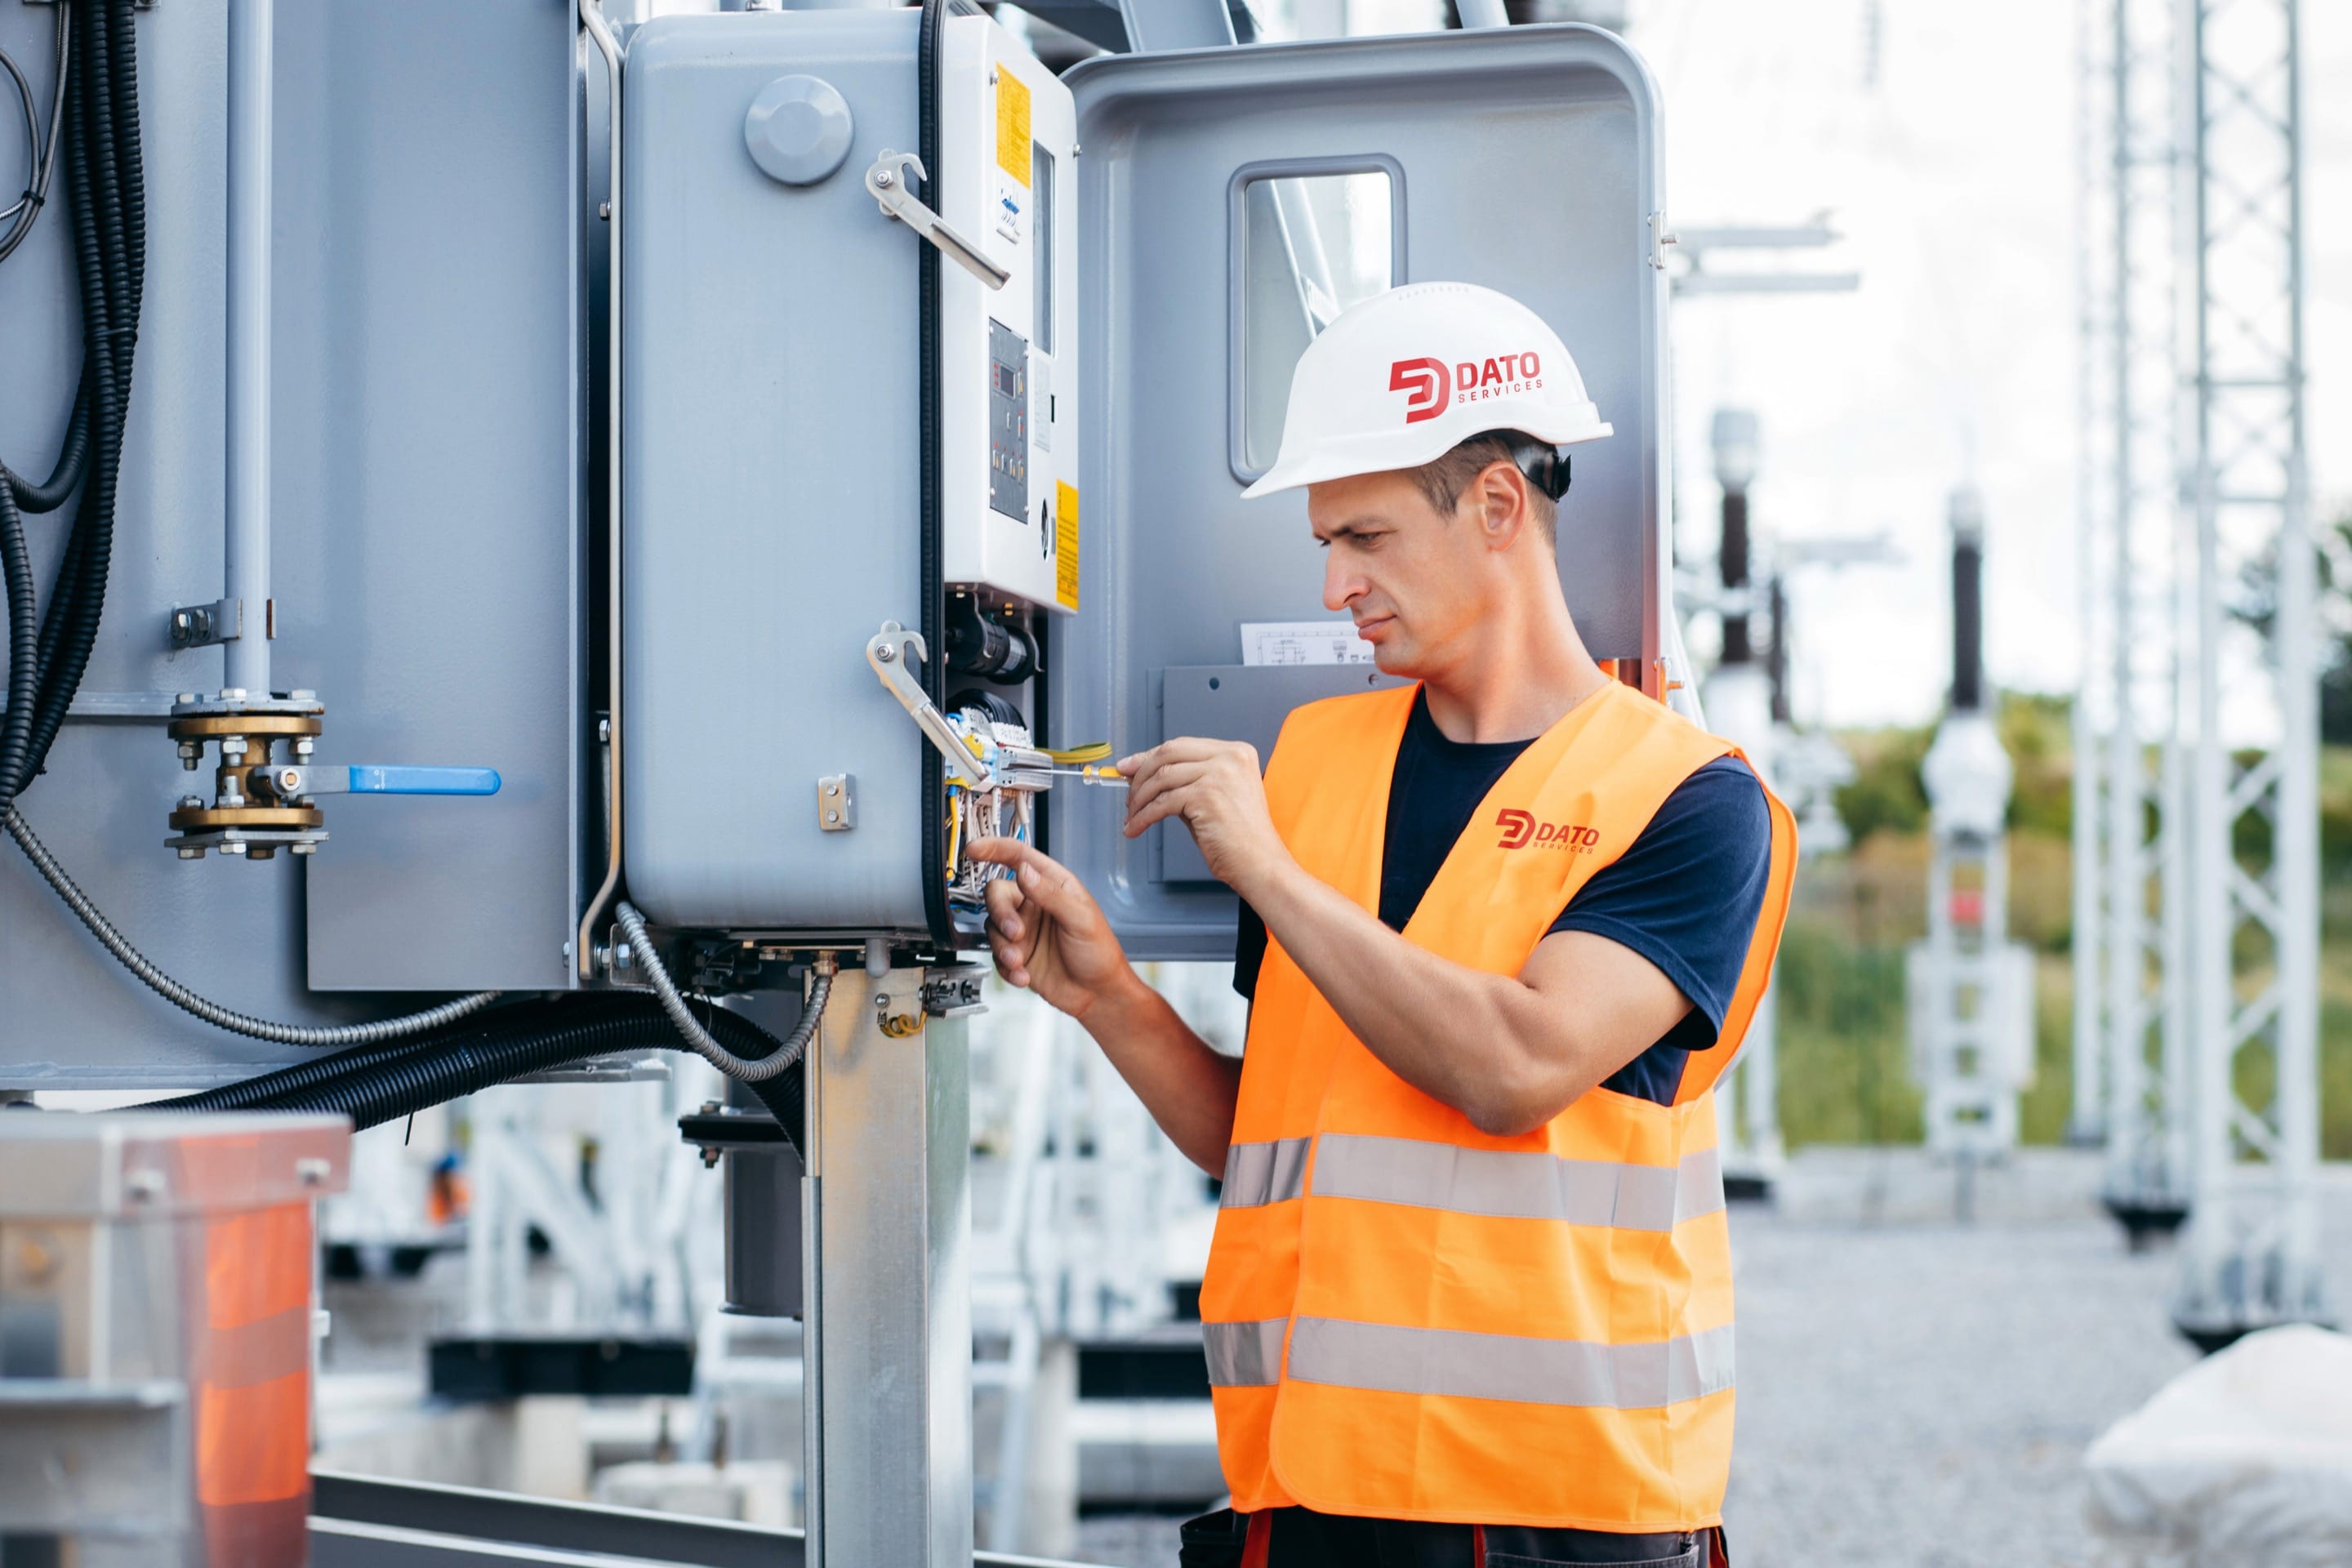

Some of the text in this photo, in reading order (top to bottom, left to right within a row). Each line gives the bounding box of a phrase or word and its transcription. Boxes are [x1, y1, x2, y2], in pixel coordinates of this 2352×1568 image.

[1456, 351, 1540, 391] DATO
[1459, 380, 1542, 403] SERVICES
[1535, 822, 1599, 846] DATO
[1533, 842, 1593, 854] SERVICES
